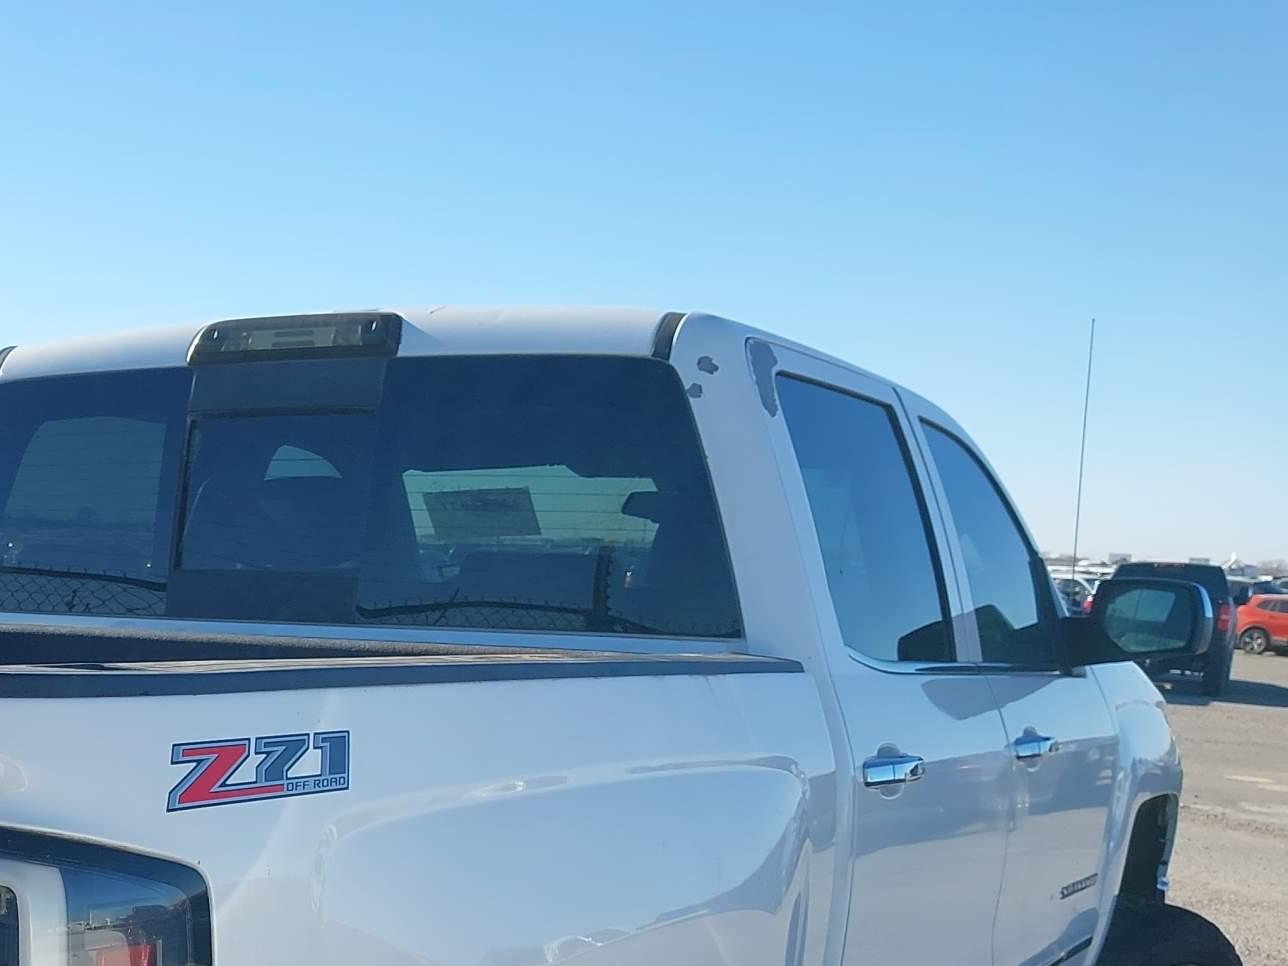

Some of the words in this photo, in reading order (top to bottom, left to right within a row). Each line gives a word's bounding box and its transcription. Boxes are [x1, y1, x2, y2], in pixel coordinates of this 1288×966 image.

[166, 730, 351, 813] Z71
[286, 780, 310, 792] OFF
[313, 775, 347, 789] ROAD
